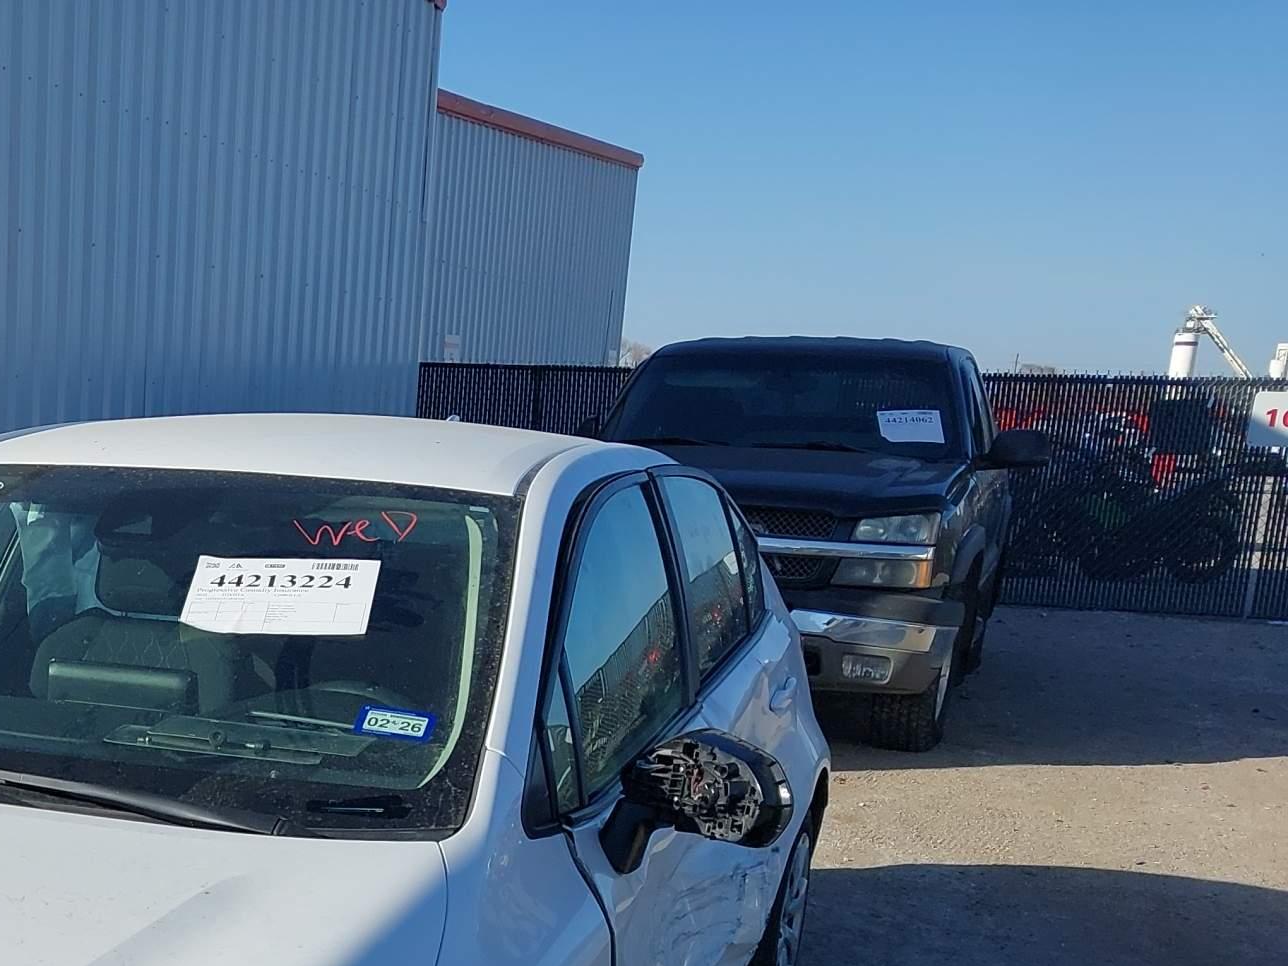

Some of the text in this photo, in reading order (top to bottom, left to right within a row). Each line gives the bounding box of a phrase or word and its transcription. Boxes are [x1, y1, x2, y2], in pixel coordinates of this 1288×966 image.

[210, 574, 353, 589] 44213224
[367, 716, 390, 729] 02
[399, 721, 424, 733] 26
